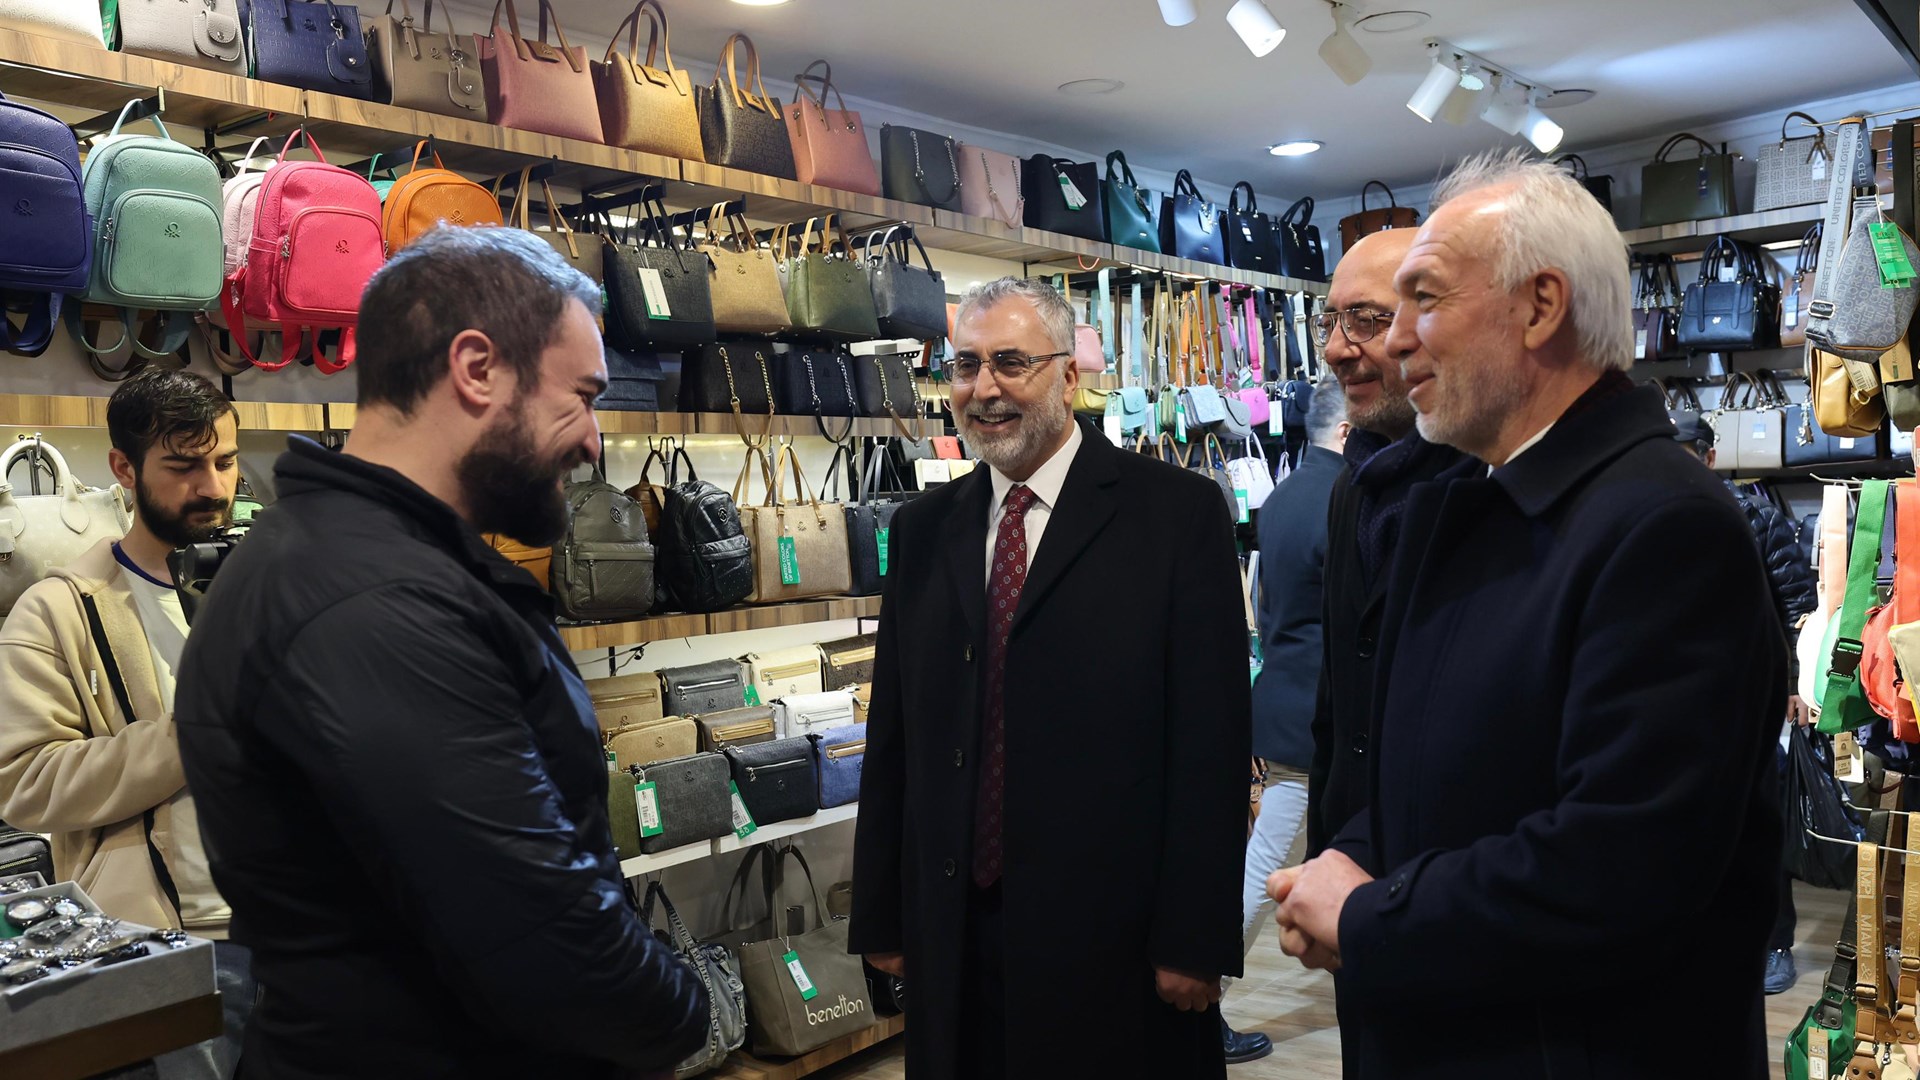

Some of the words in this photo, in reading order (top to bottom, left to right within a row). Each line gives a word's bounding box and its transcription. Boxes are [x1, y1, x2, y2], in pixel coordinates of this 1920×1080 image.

[1858, 161, 1868, 185] ITED
[1832, 186, 1844, 224] UNITED
[1861, 914, 1872, 957] MIAMI
[804, 994, 864, 1025] benetton
